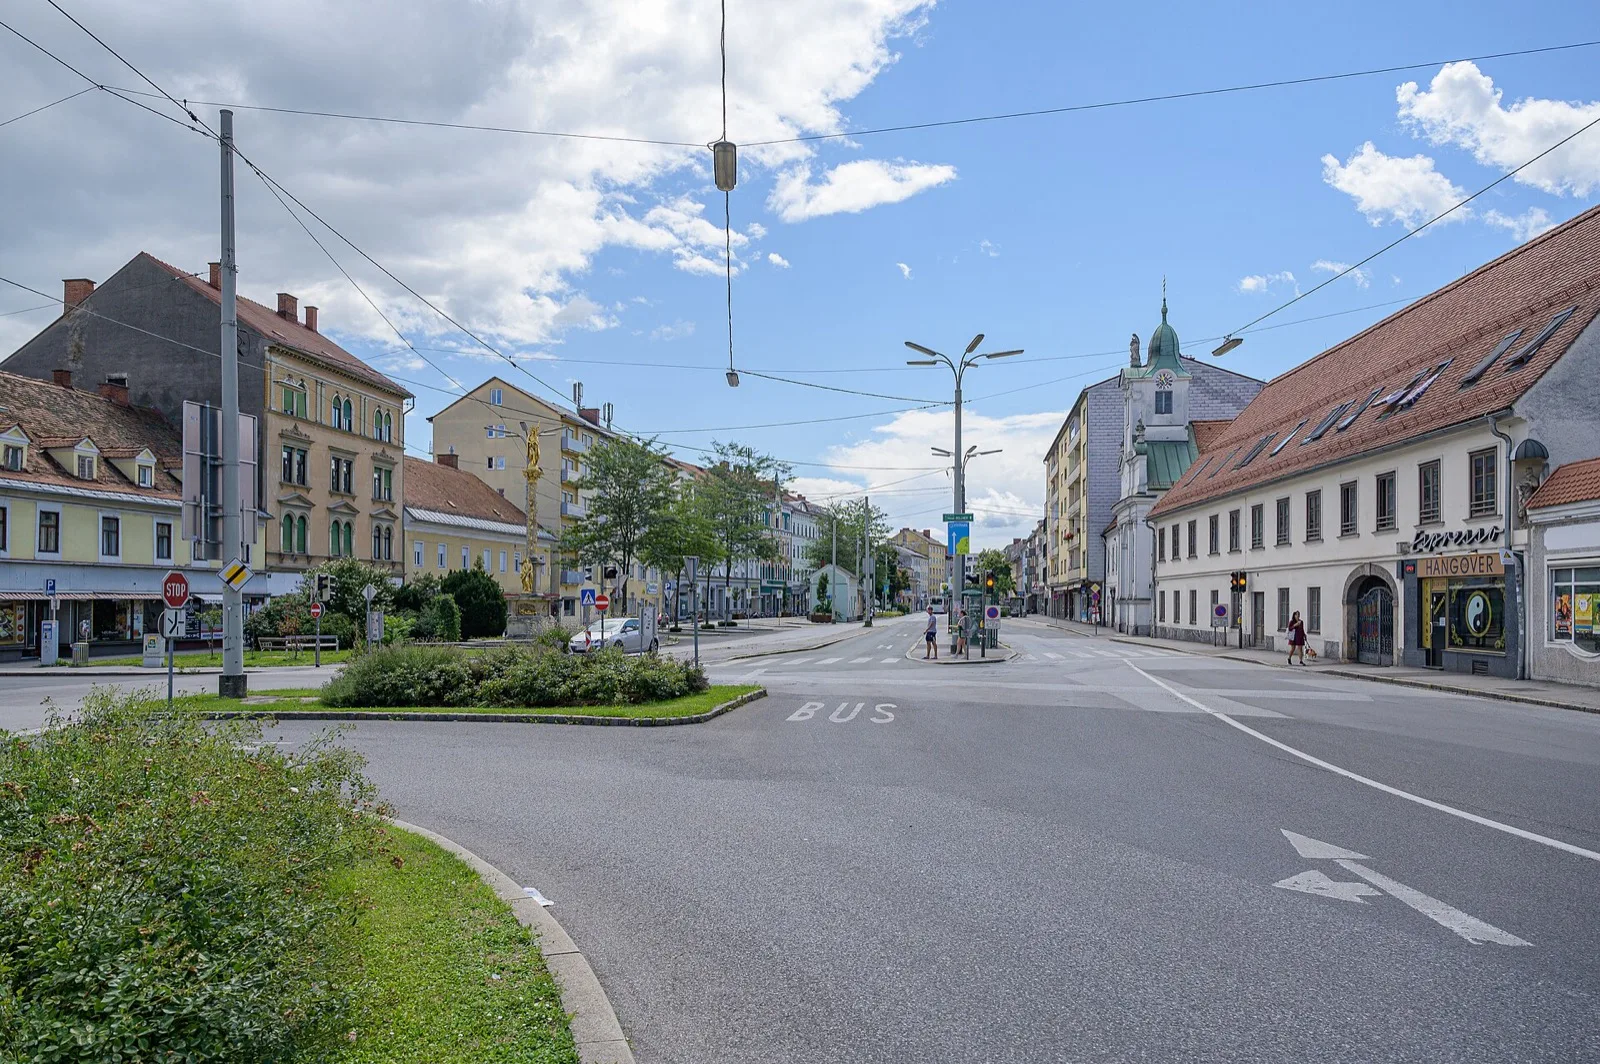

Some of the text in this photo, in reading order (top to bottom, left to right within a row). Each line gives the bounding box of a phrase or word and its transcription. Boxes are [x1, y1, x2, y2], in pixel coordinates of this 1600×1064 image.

[1412, 526, 1505, 553] Espresso
[1426, 555, 1494, 576] HANGOVER
[48, 580, 54, 589] P
[166, 583, 186, 597] STOP
[785, 701, 898, 724] BUS
